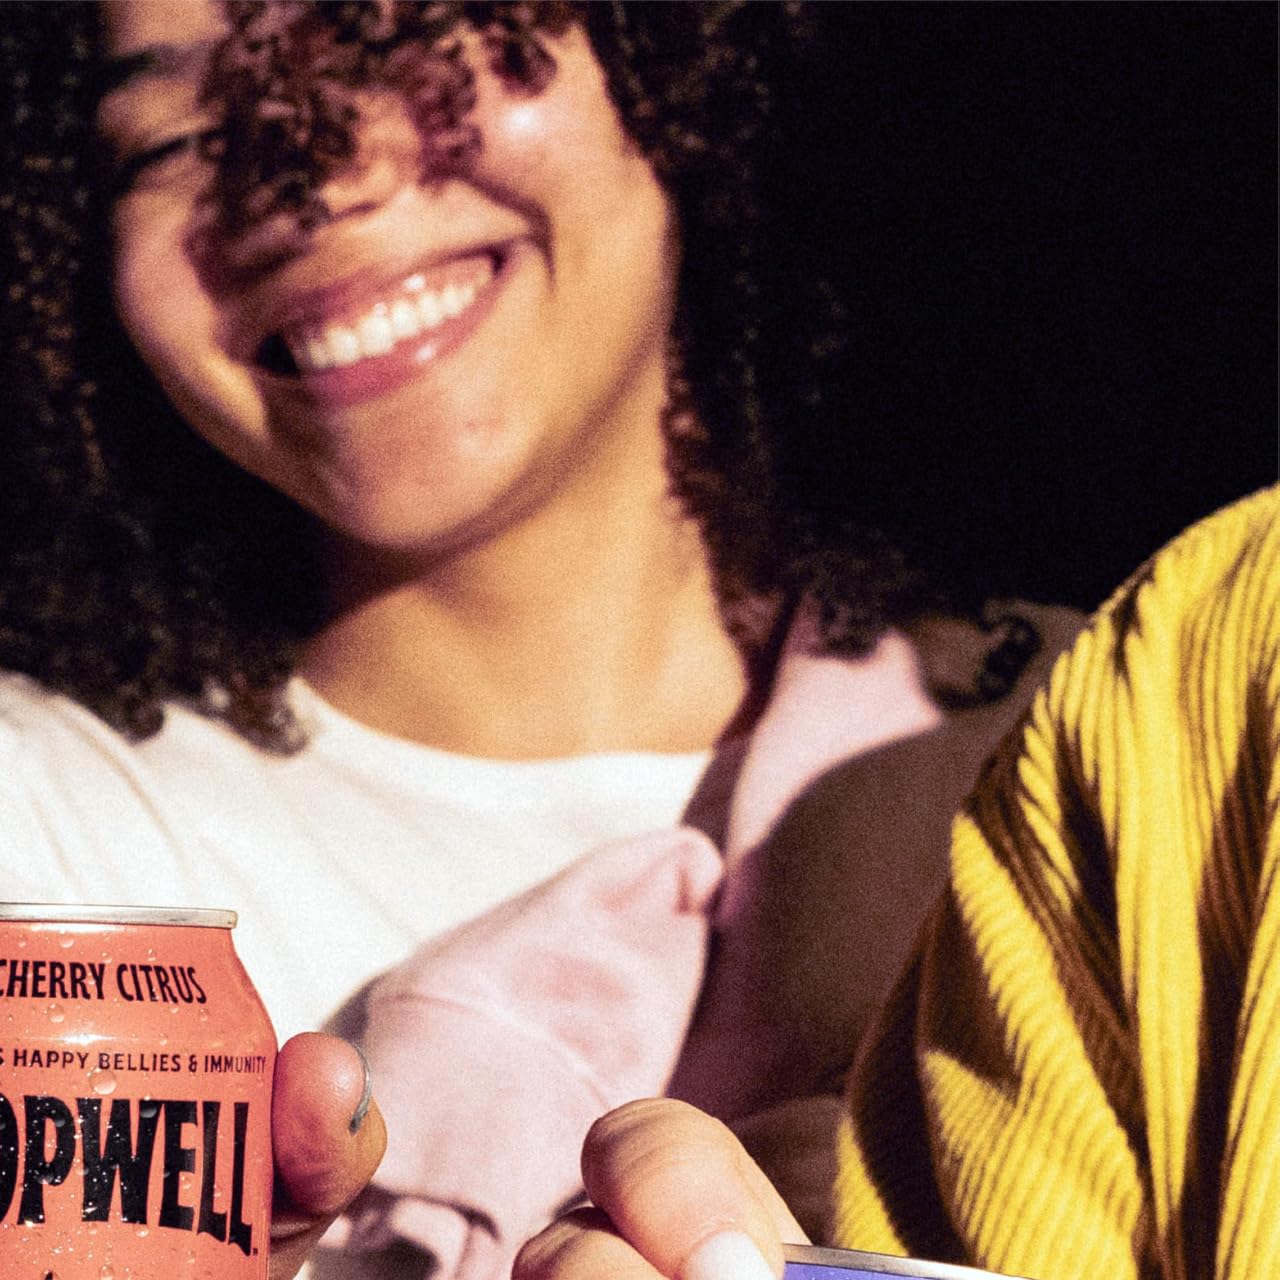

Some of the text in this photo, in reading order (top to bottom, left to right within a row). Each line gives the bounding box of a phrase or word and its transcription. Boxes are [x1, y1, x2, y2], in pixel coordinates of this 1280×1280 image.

[116, 963, 208, 1004] CITRUS
[13, 1050, 90, 1071] HAPPY
[98, 1052, 182, 1073] BELLIES
[188, 1056, 198, 1073] &
[204, 1055, 267, 1074] IMMUNITY
